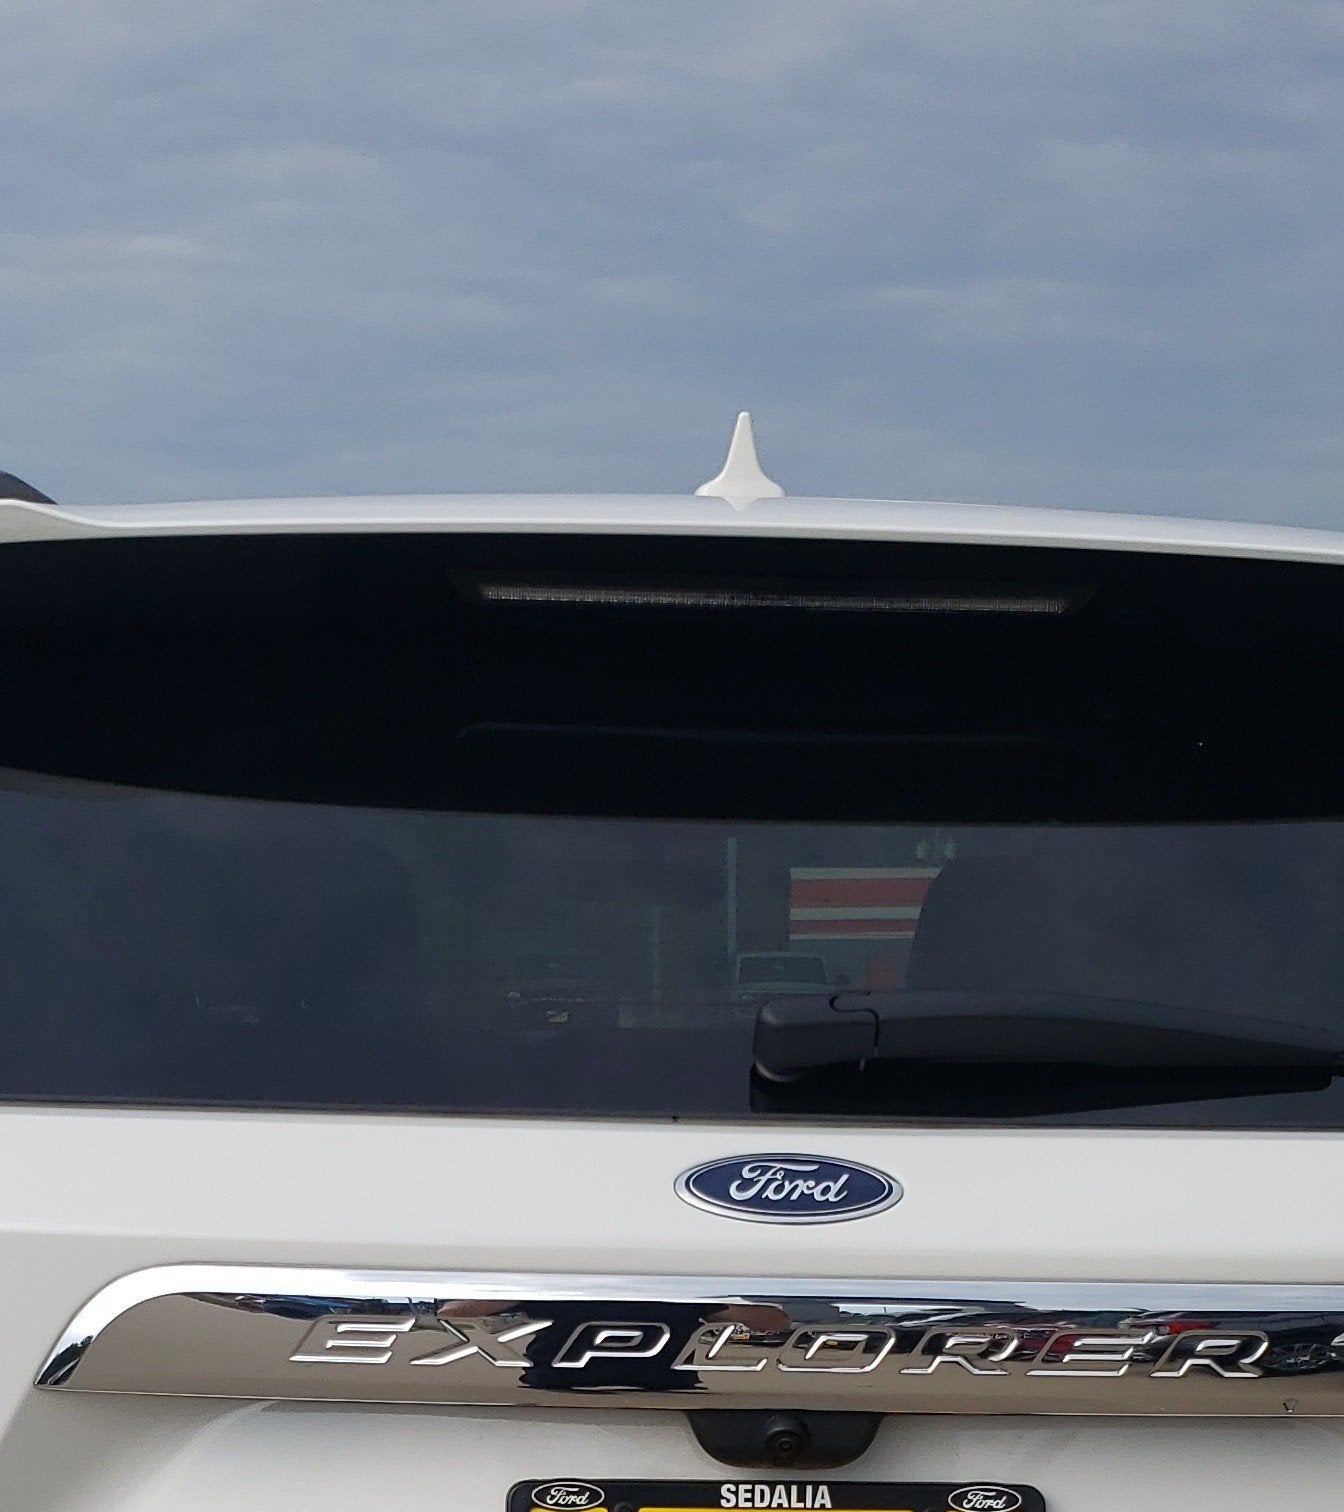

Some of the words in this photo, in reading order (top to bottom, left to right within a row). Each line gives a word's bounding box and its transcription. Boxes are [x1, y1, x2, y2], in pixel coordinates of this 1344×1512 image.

[729, 1161, 850, 1203] Ford
[289, 1315, 1269, 1378] EXPLORER
[546, 1486, 590, 1506] Ford
[720, 1483, 833, 1509] SEDALIA
[962, 1490, 1007, 1510] Ford
